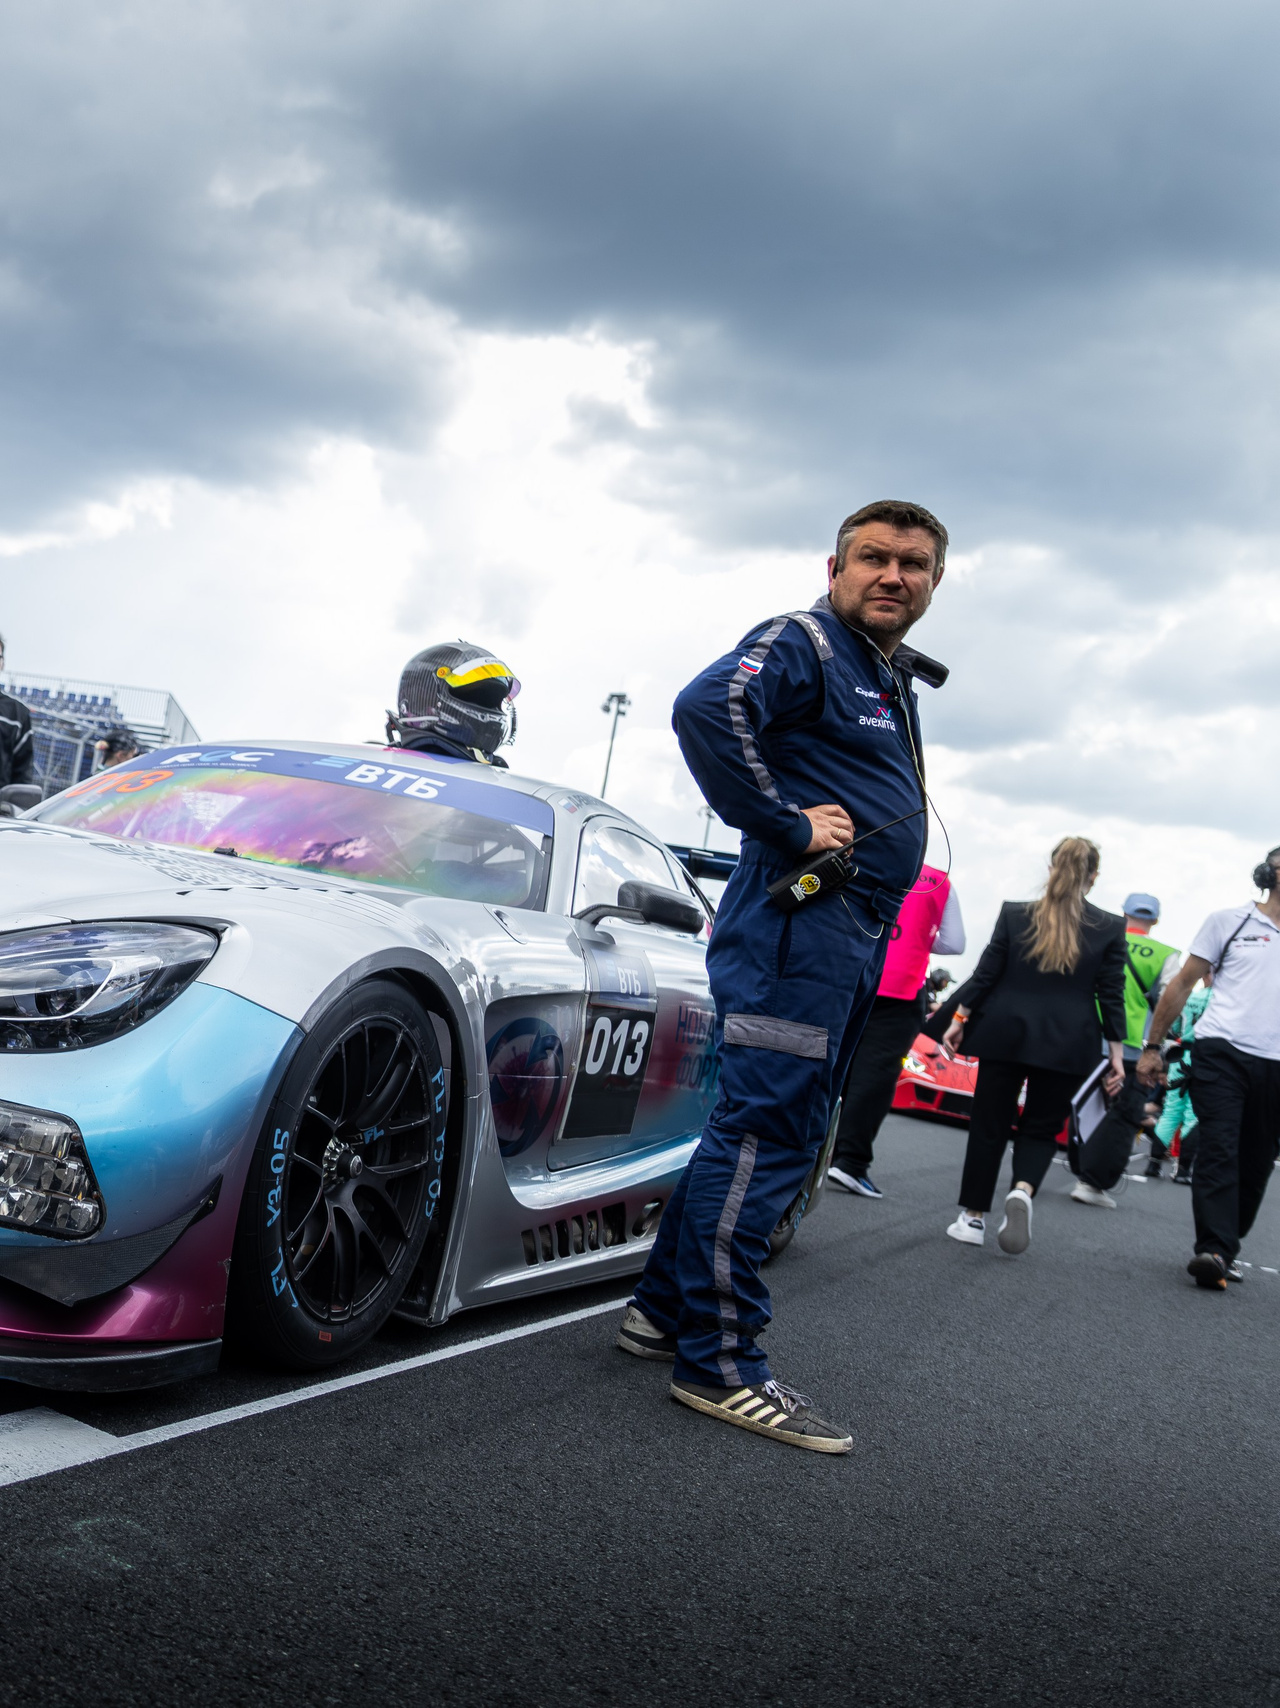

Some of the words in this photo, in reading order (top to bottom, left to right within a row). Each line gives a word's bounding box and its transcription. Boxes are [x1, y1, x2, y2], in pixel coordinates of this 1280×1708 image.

[858, 714, 896, 731] avexima
[160, 750, 274, 765] ROC
[65, 770, 174, 798] 013
[345, 764, 447, 799] ВТБ
[617, 967, 642, 996] ВТБ
[676, 1005, 716, 1047] НОБА
[585, 1016, 650, 1076] 013
[675, 1053, 722, 1092] ФОРТ
[363, 1126, 385, 1145] FL
